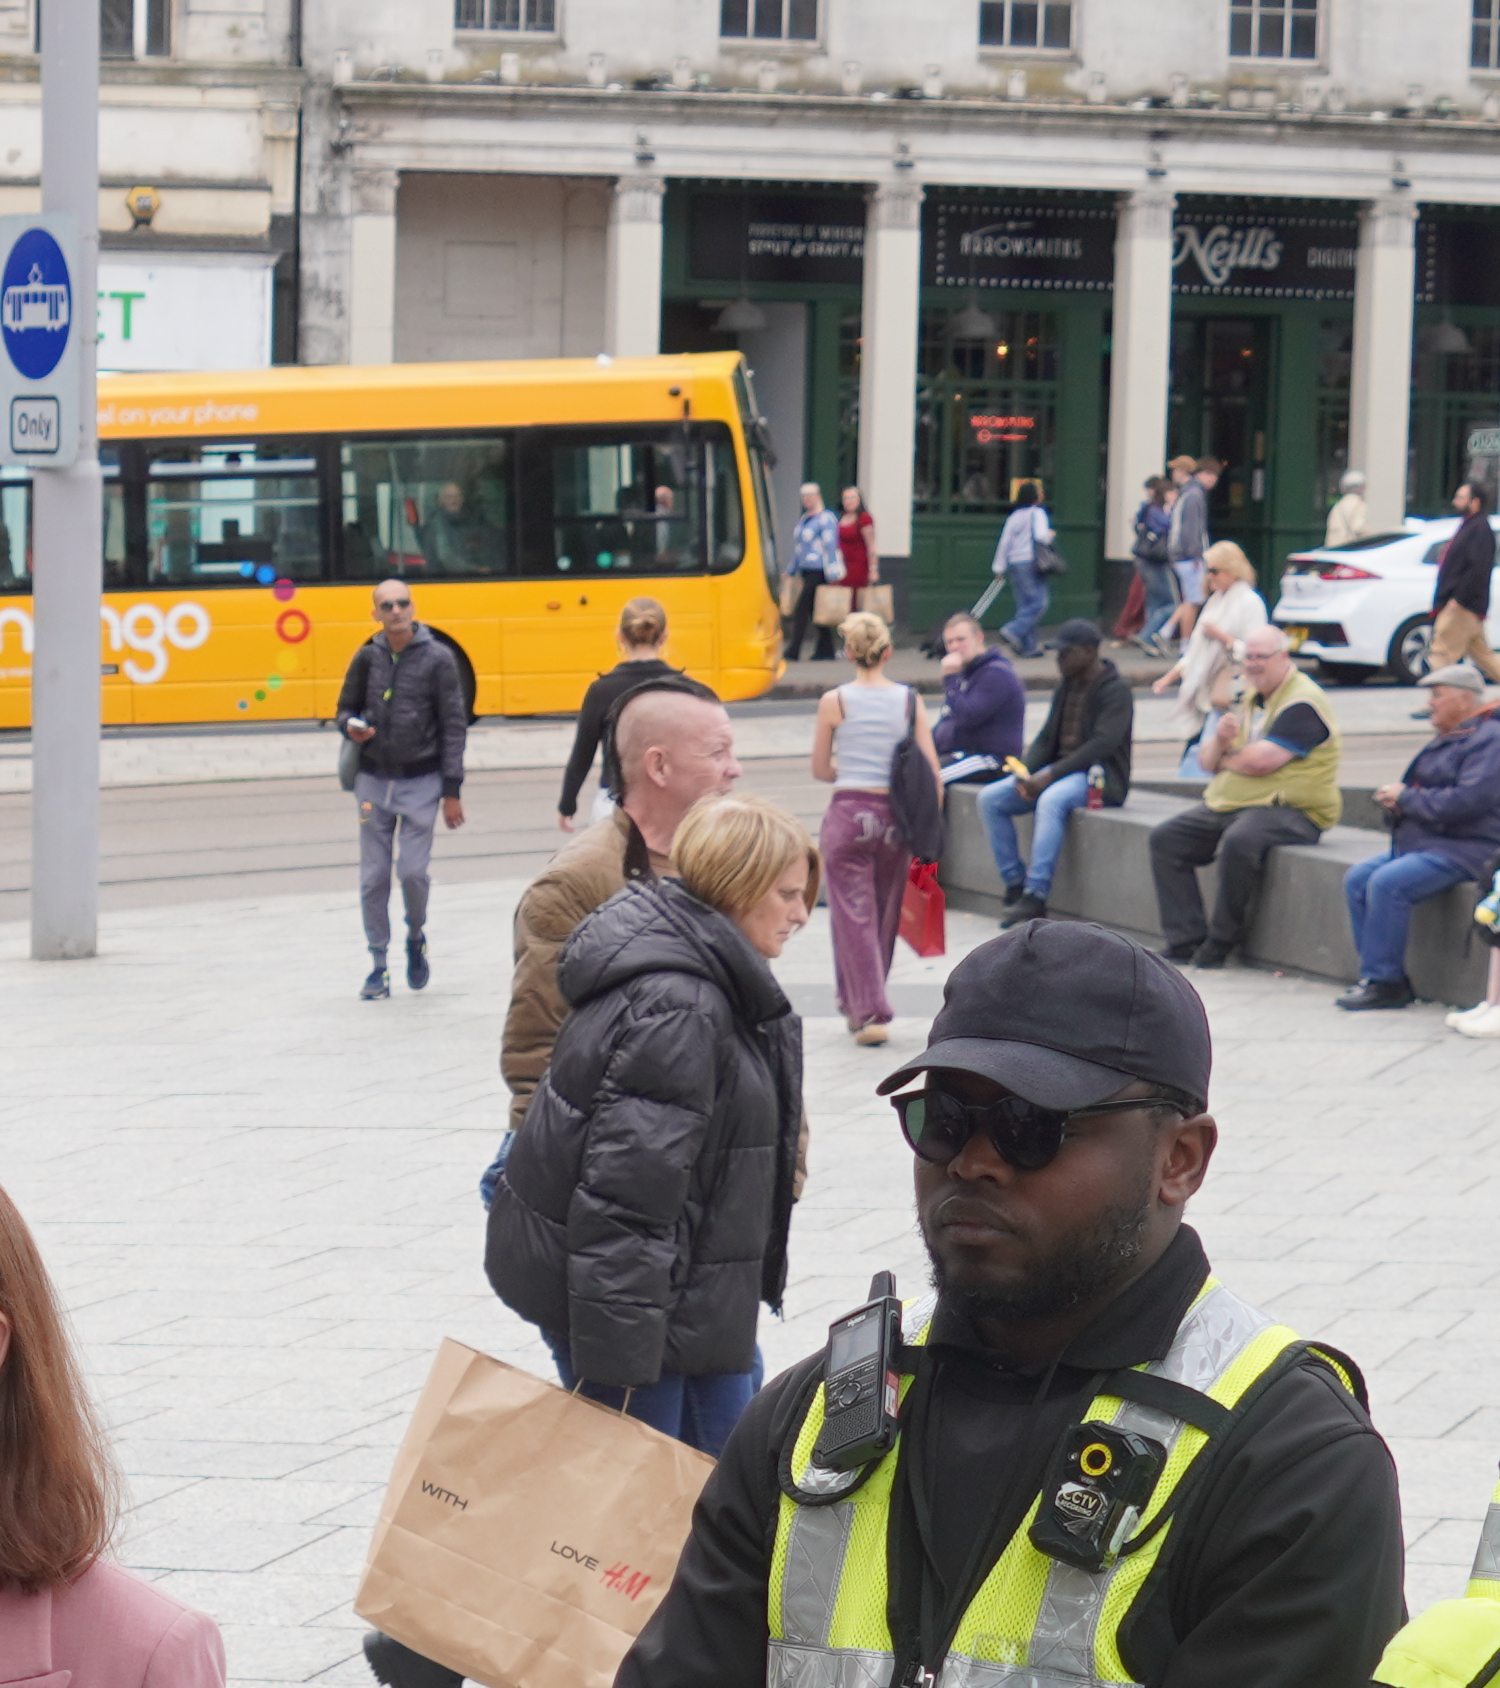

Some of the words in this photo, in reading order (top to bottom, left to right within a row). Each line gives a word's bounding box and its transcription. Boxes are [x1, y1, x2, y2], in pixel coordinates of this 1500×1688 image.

[17, 412, 52, 441] Only
[421, 1479, 469, 1511] WITH
[550, 1540, 600, 1572] LOVE
[599, 1561, 652, 1602] H&M
